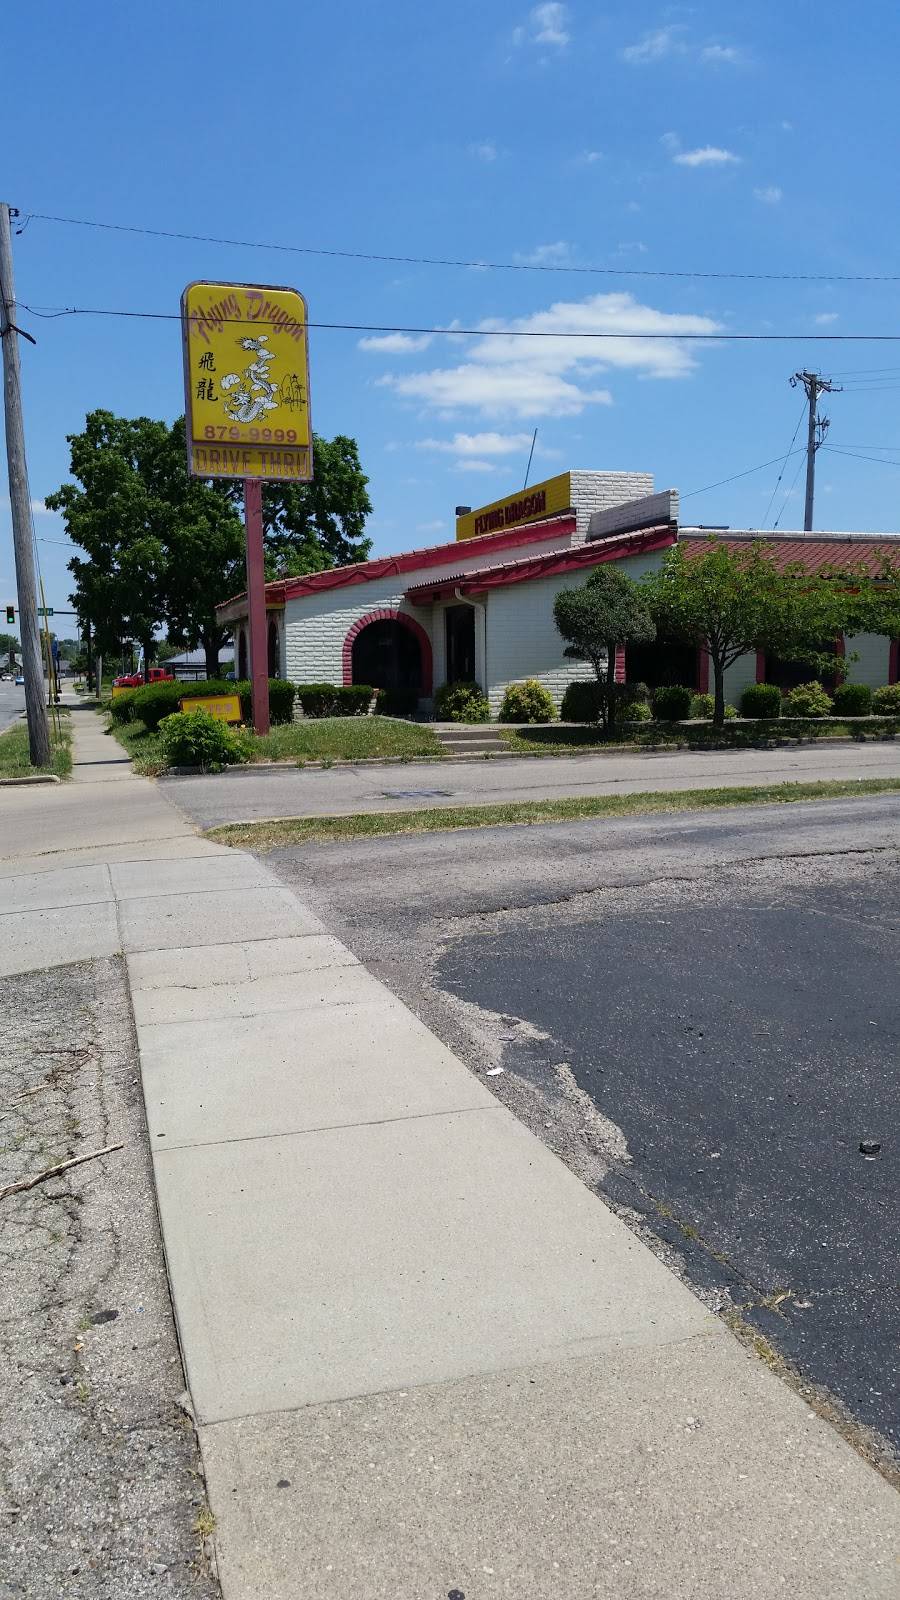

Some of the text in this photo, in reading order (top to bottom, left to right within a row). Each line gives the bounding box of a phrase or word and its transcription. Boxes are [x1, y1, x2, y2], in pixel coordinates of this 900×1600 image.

[190, 291, 304, 344] Flying Dragon
[204, 425, 297, 443] 879-9999
[196, 448, 307, 476] DRIVE THRU
[475, 489, 546, 535] FLYING DRAGON
